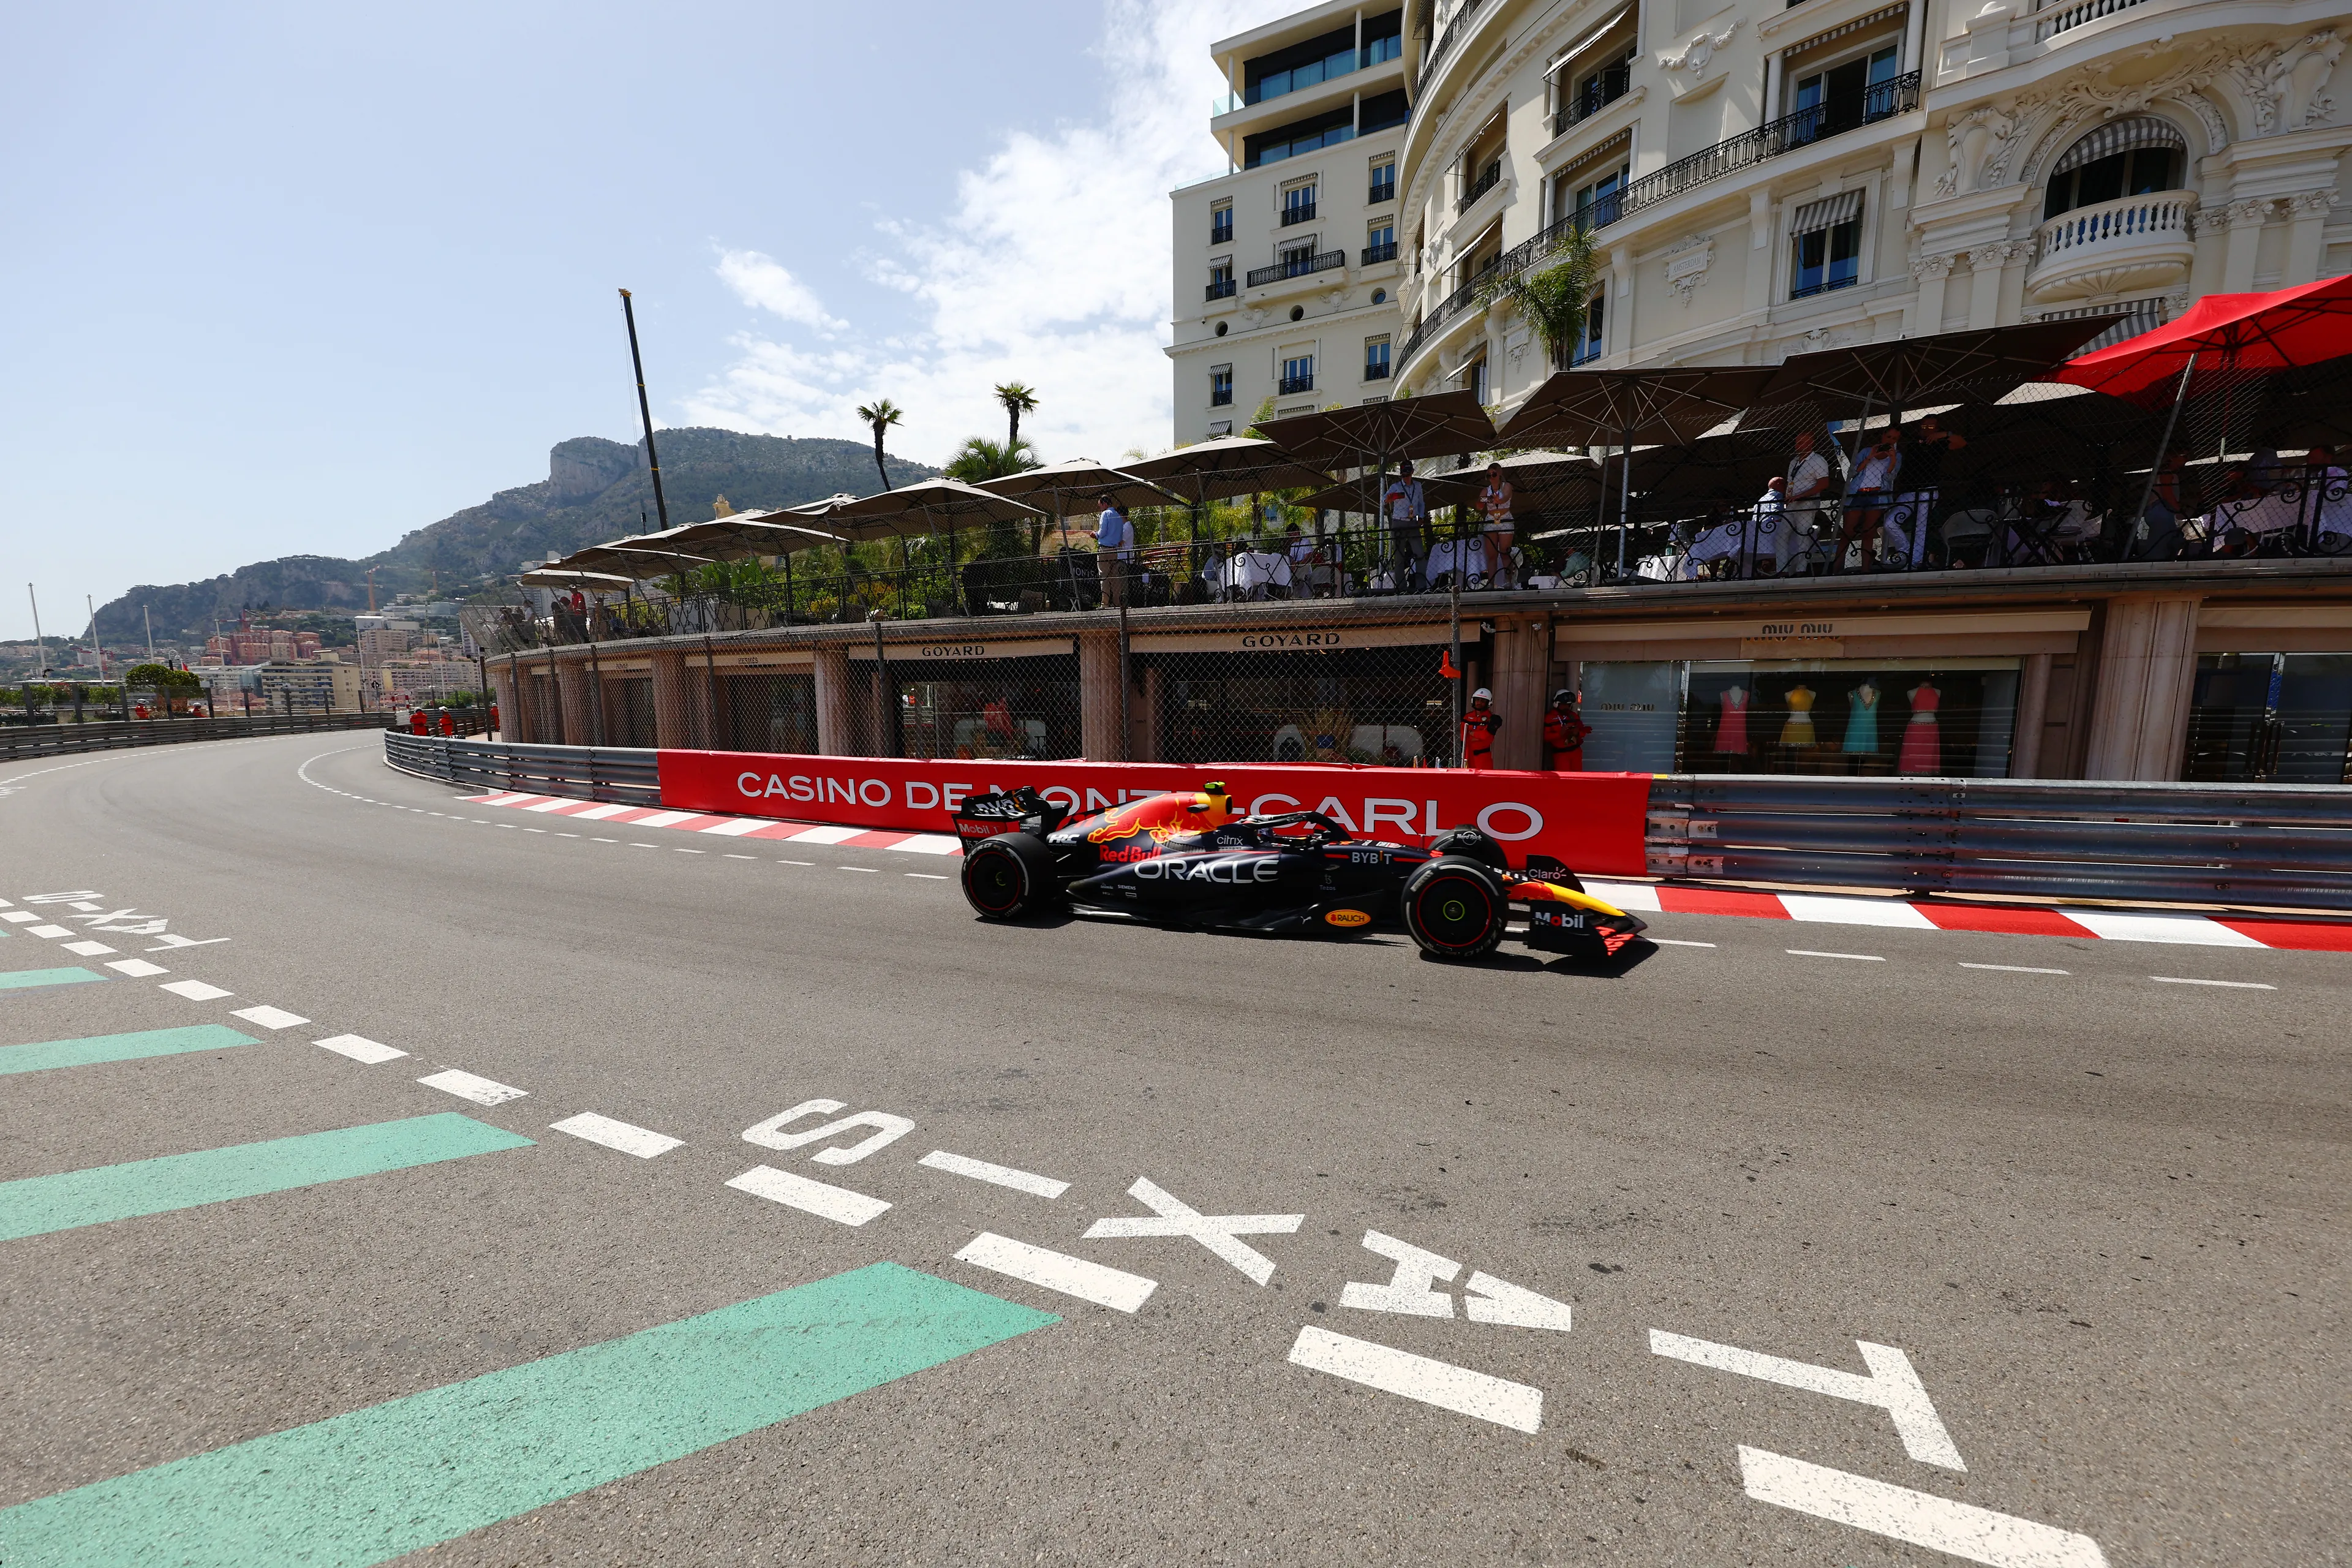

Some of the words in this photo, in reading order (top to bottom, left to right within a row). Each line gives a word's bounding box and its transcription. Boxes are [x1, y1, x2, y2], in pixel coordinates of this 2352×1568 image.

[1673, 255, 1702, 273] AMSTERDAM
[1242, 633, 1340, 647] GOYARD
[922, 646, 985, 657] GOYARD
[737, 772, 891, 807] CASINO
[905, 781, 973, 812] DE
[959, 823, 990, 834] Mobil
[1048, 834, 1080, 844] HRC
[1216, 835, 1243, 846] citrix
[1099, 845, 1130, 862] Red
[1352, 850, 1392, 865] BYBIT
[1134, 859, 1279, 883] ORACLE
[1535, 911, 1584, 929] Mobil
[741, 1098, 1969, 1473] TAXIS
